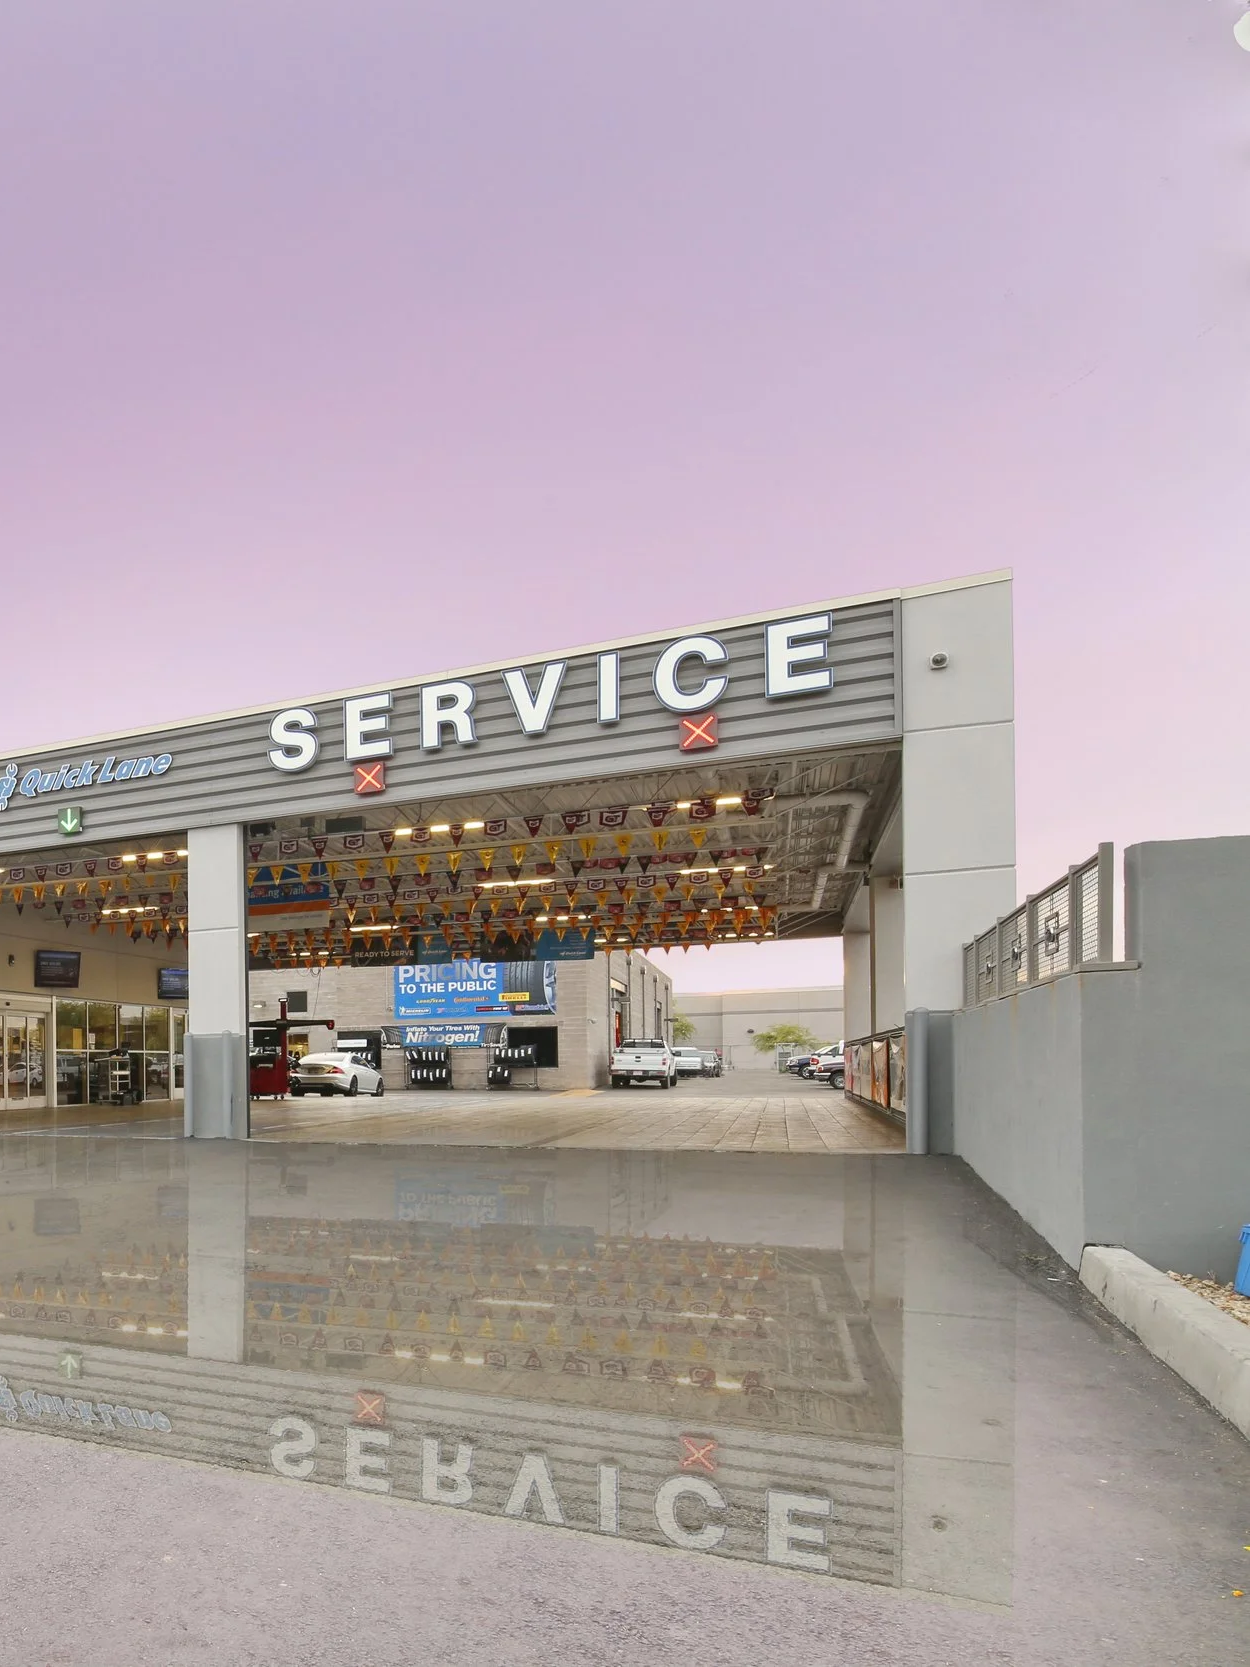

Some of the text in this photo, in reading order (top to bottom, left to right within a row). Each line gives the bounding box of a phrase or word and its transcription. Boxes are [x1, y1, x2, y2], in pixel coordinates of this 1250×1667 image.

[267, 612, 834, 773] SERVICE
[19, 753, 173, 797] Quick Lane
[399, 961, 496, 983] PRICING
[399, 980, 497, 994] TO THE PUBLIC
[405, 1031, 480, 1046] Nitrogen!
